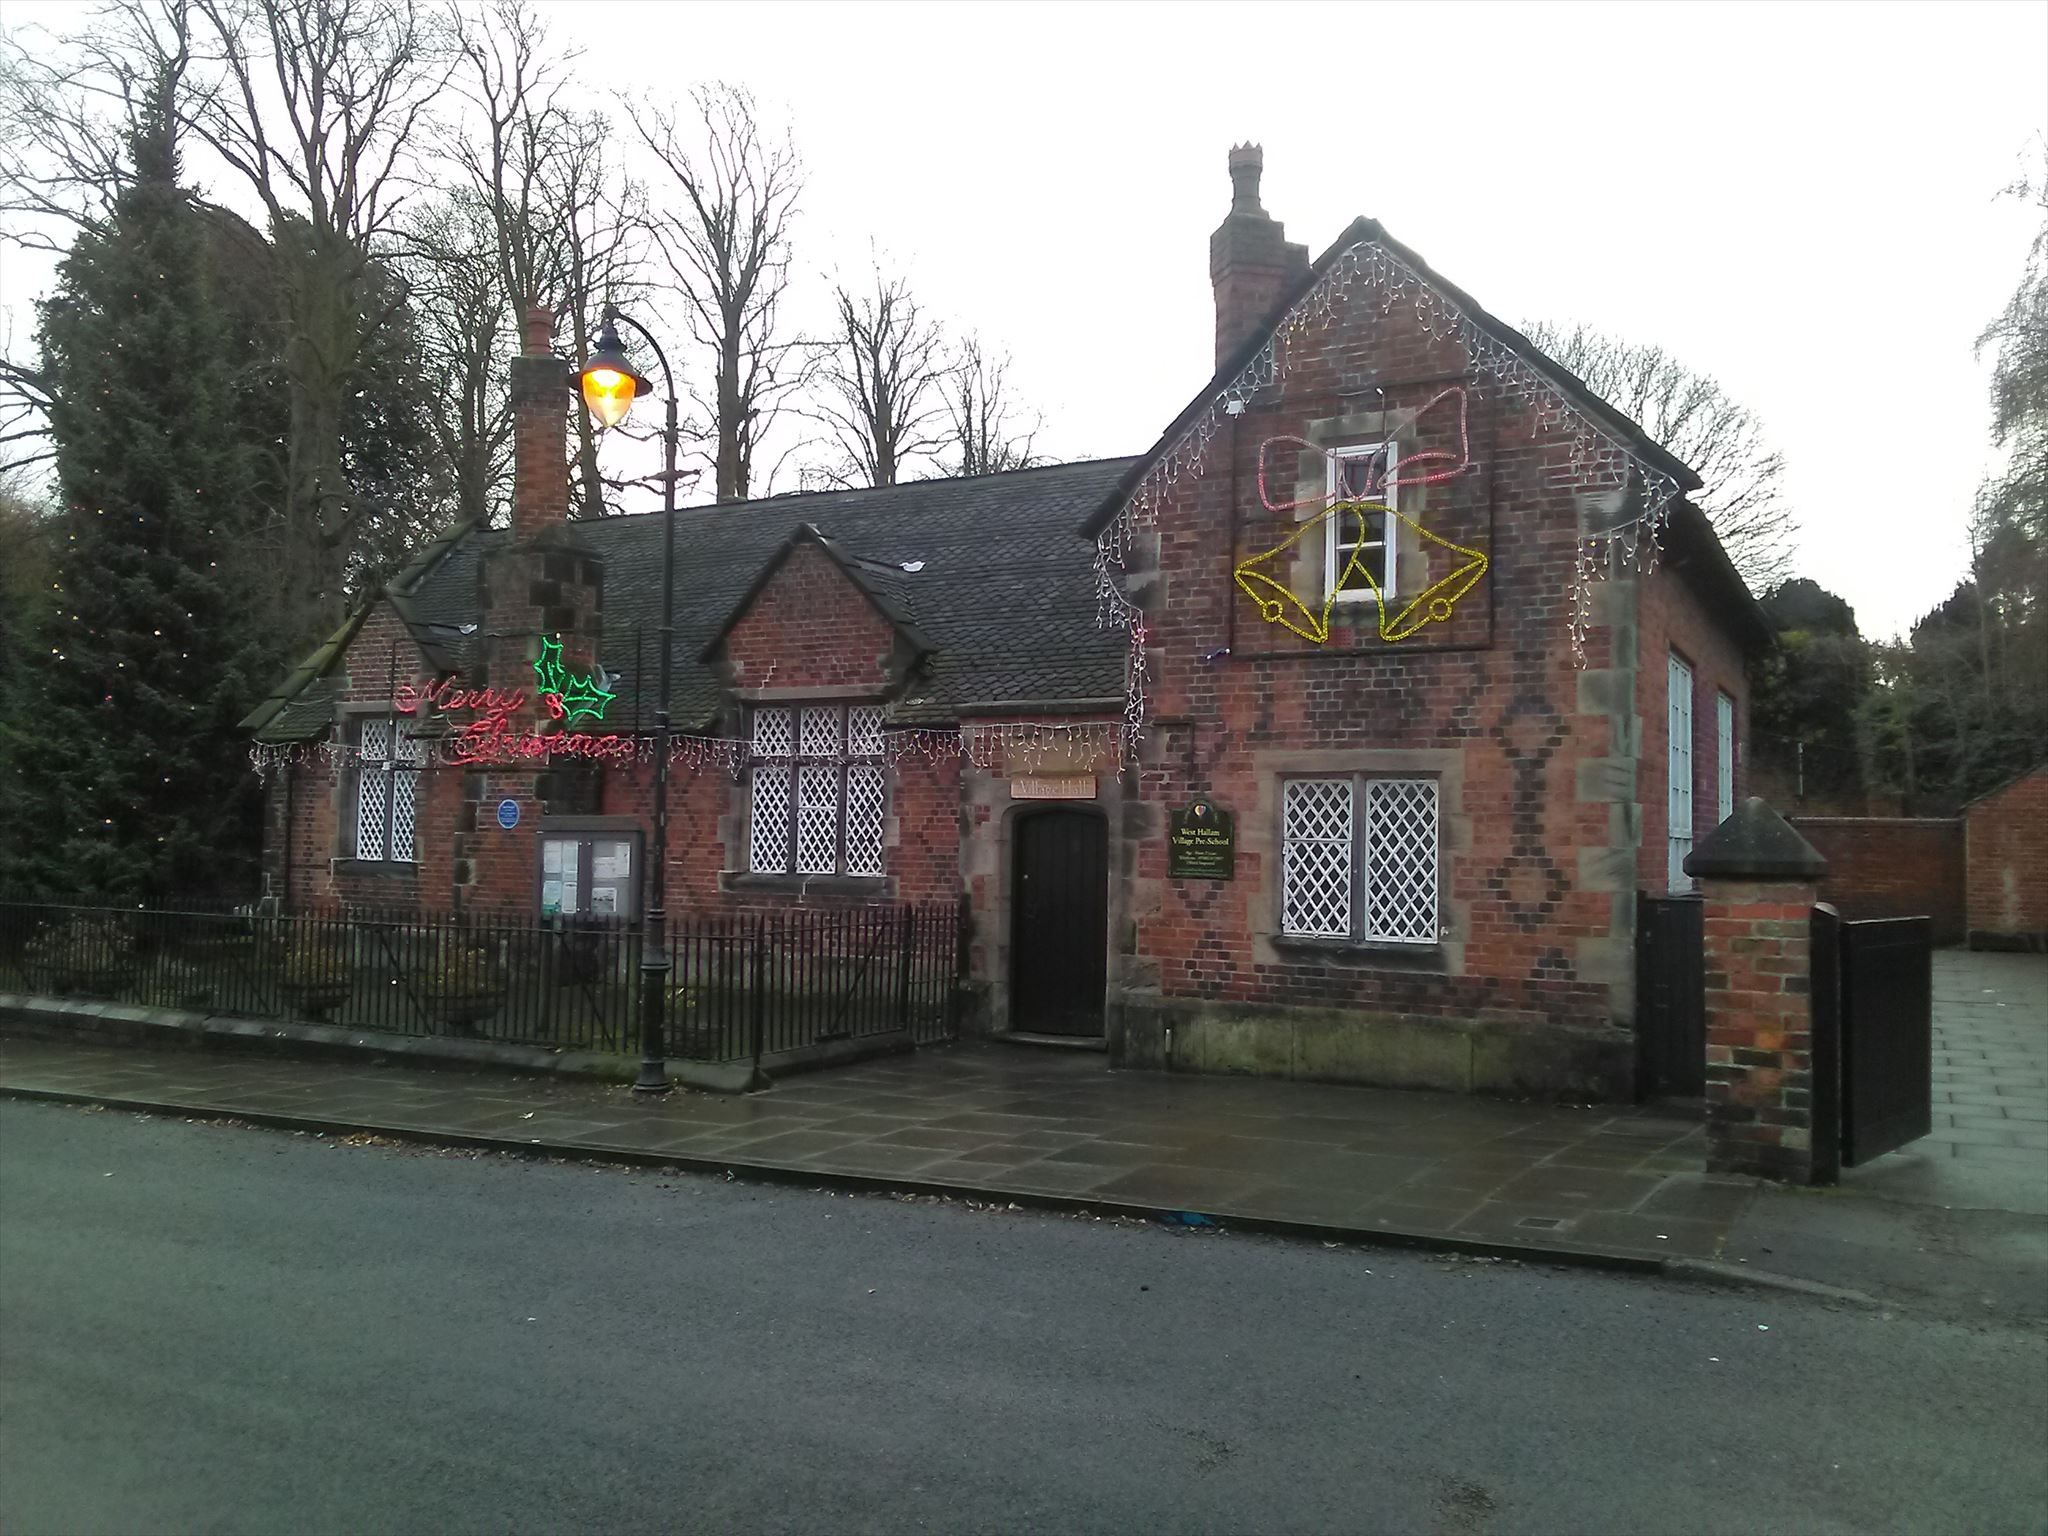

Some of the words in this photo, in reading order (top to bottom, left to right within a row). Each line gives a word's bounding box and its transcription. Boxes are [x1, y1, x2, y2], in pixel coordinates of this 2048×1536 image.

[394, 675, 525, 721] Merry
[438, 718, 635, 767] Christmas
[1020, 779, 1057, 795] Village
[1061, 779, 1086, 794] Hall
[1180, 828, 1196, 836] West
[1197, 828, 1220, 836] Hallam
[1172, 836, 1194, 846] Village
